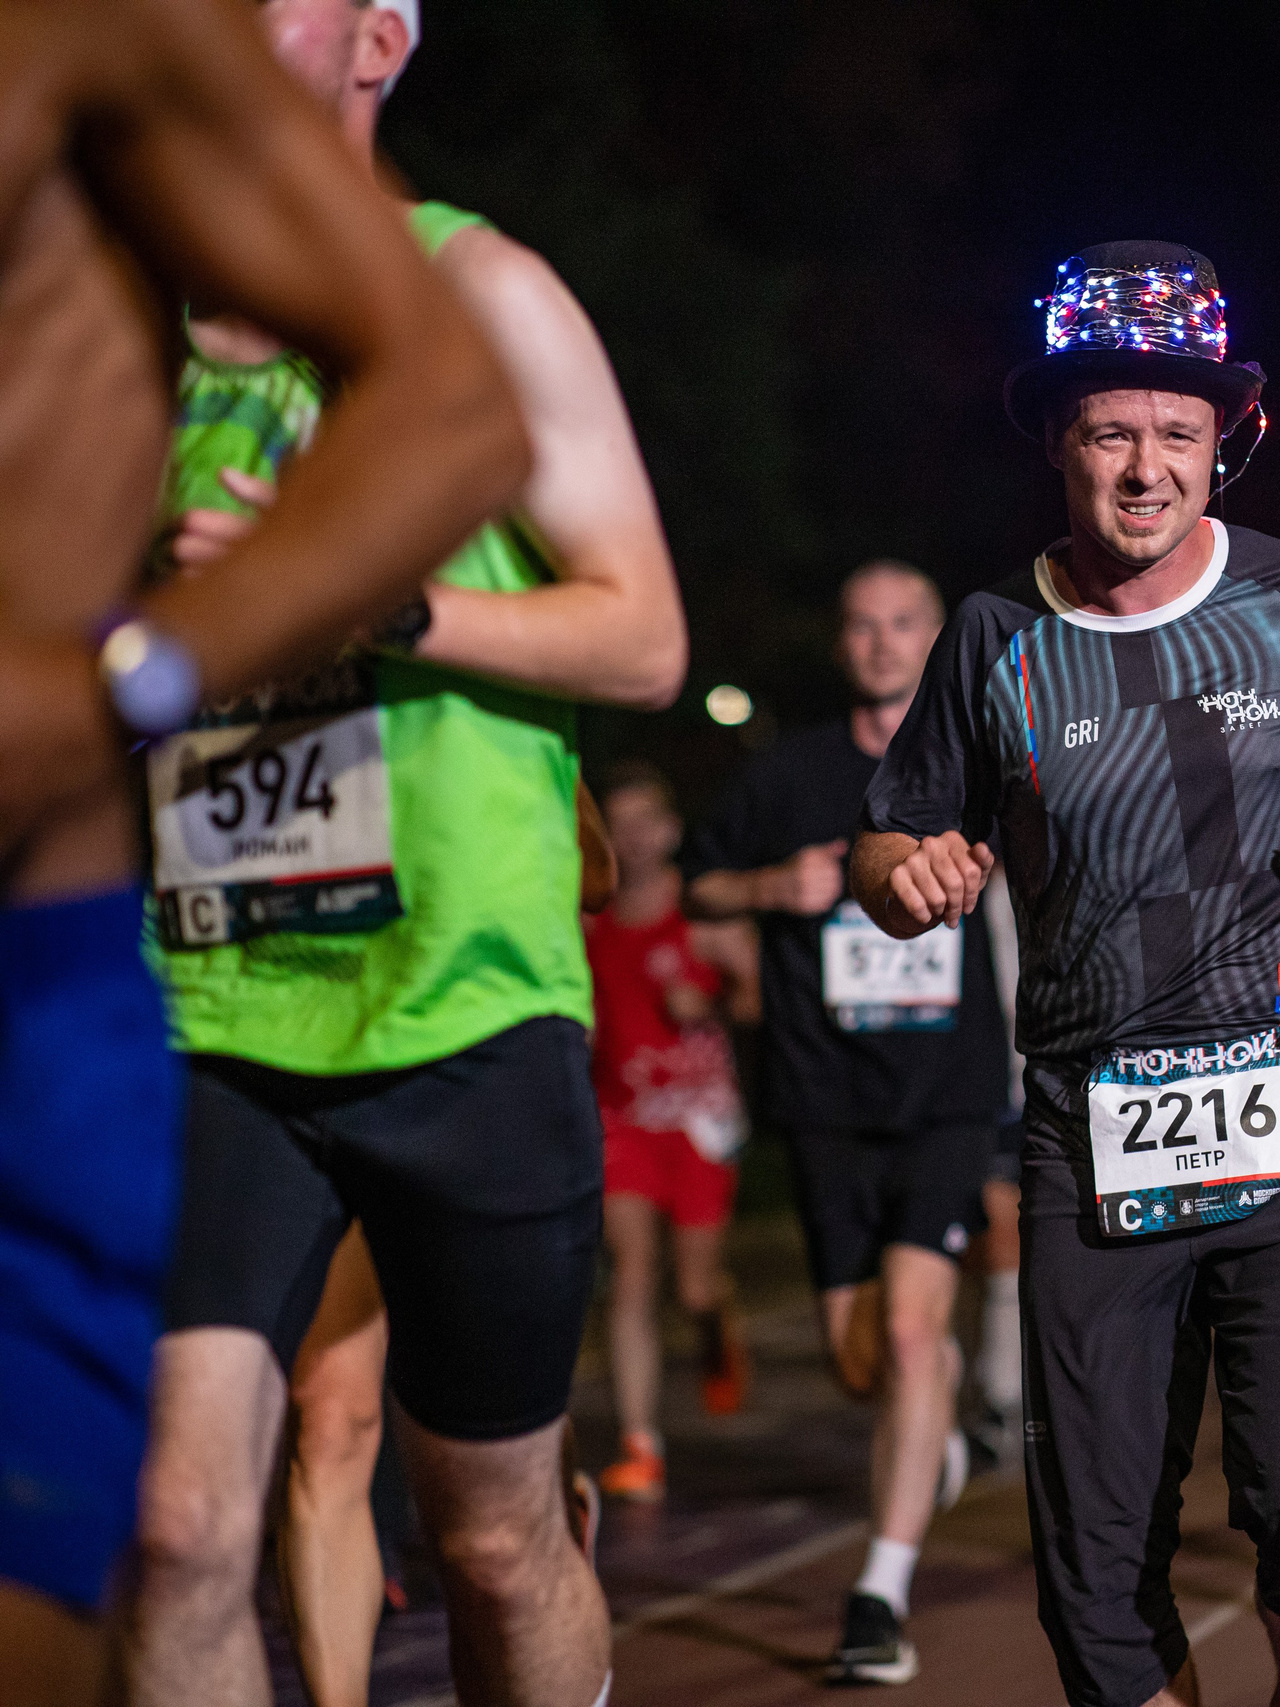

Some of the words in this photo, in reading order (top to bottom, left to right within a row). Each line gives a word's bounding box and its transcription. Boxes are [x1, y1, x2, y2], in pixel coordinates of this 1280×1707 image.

[1064, 717, 1100, 749] GRi
[1220, 721, 1262, 734] ЗАБЕГ
[205, 741, 337, 831] 594
[1118, 1083, 1276, 1154] 2216
[1175, 1150, 1225, 1171] ПЕТР
